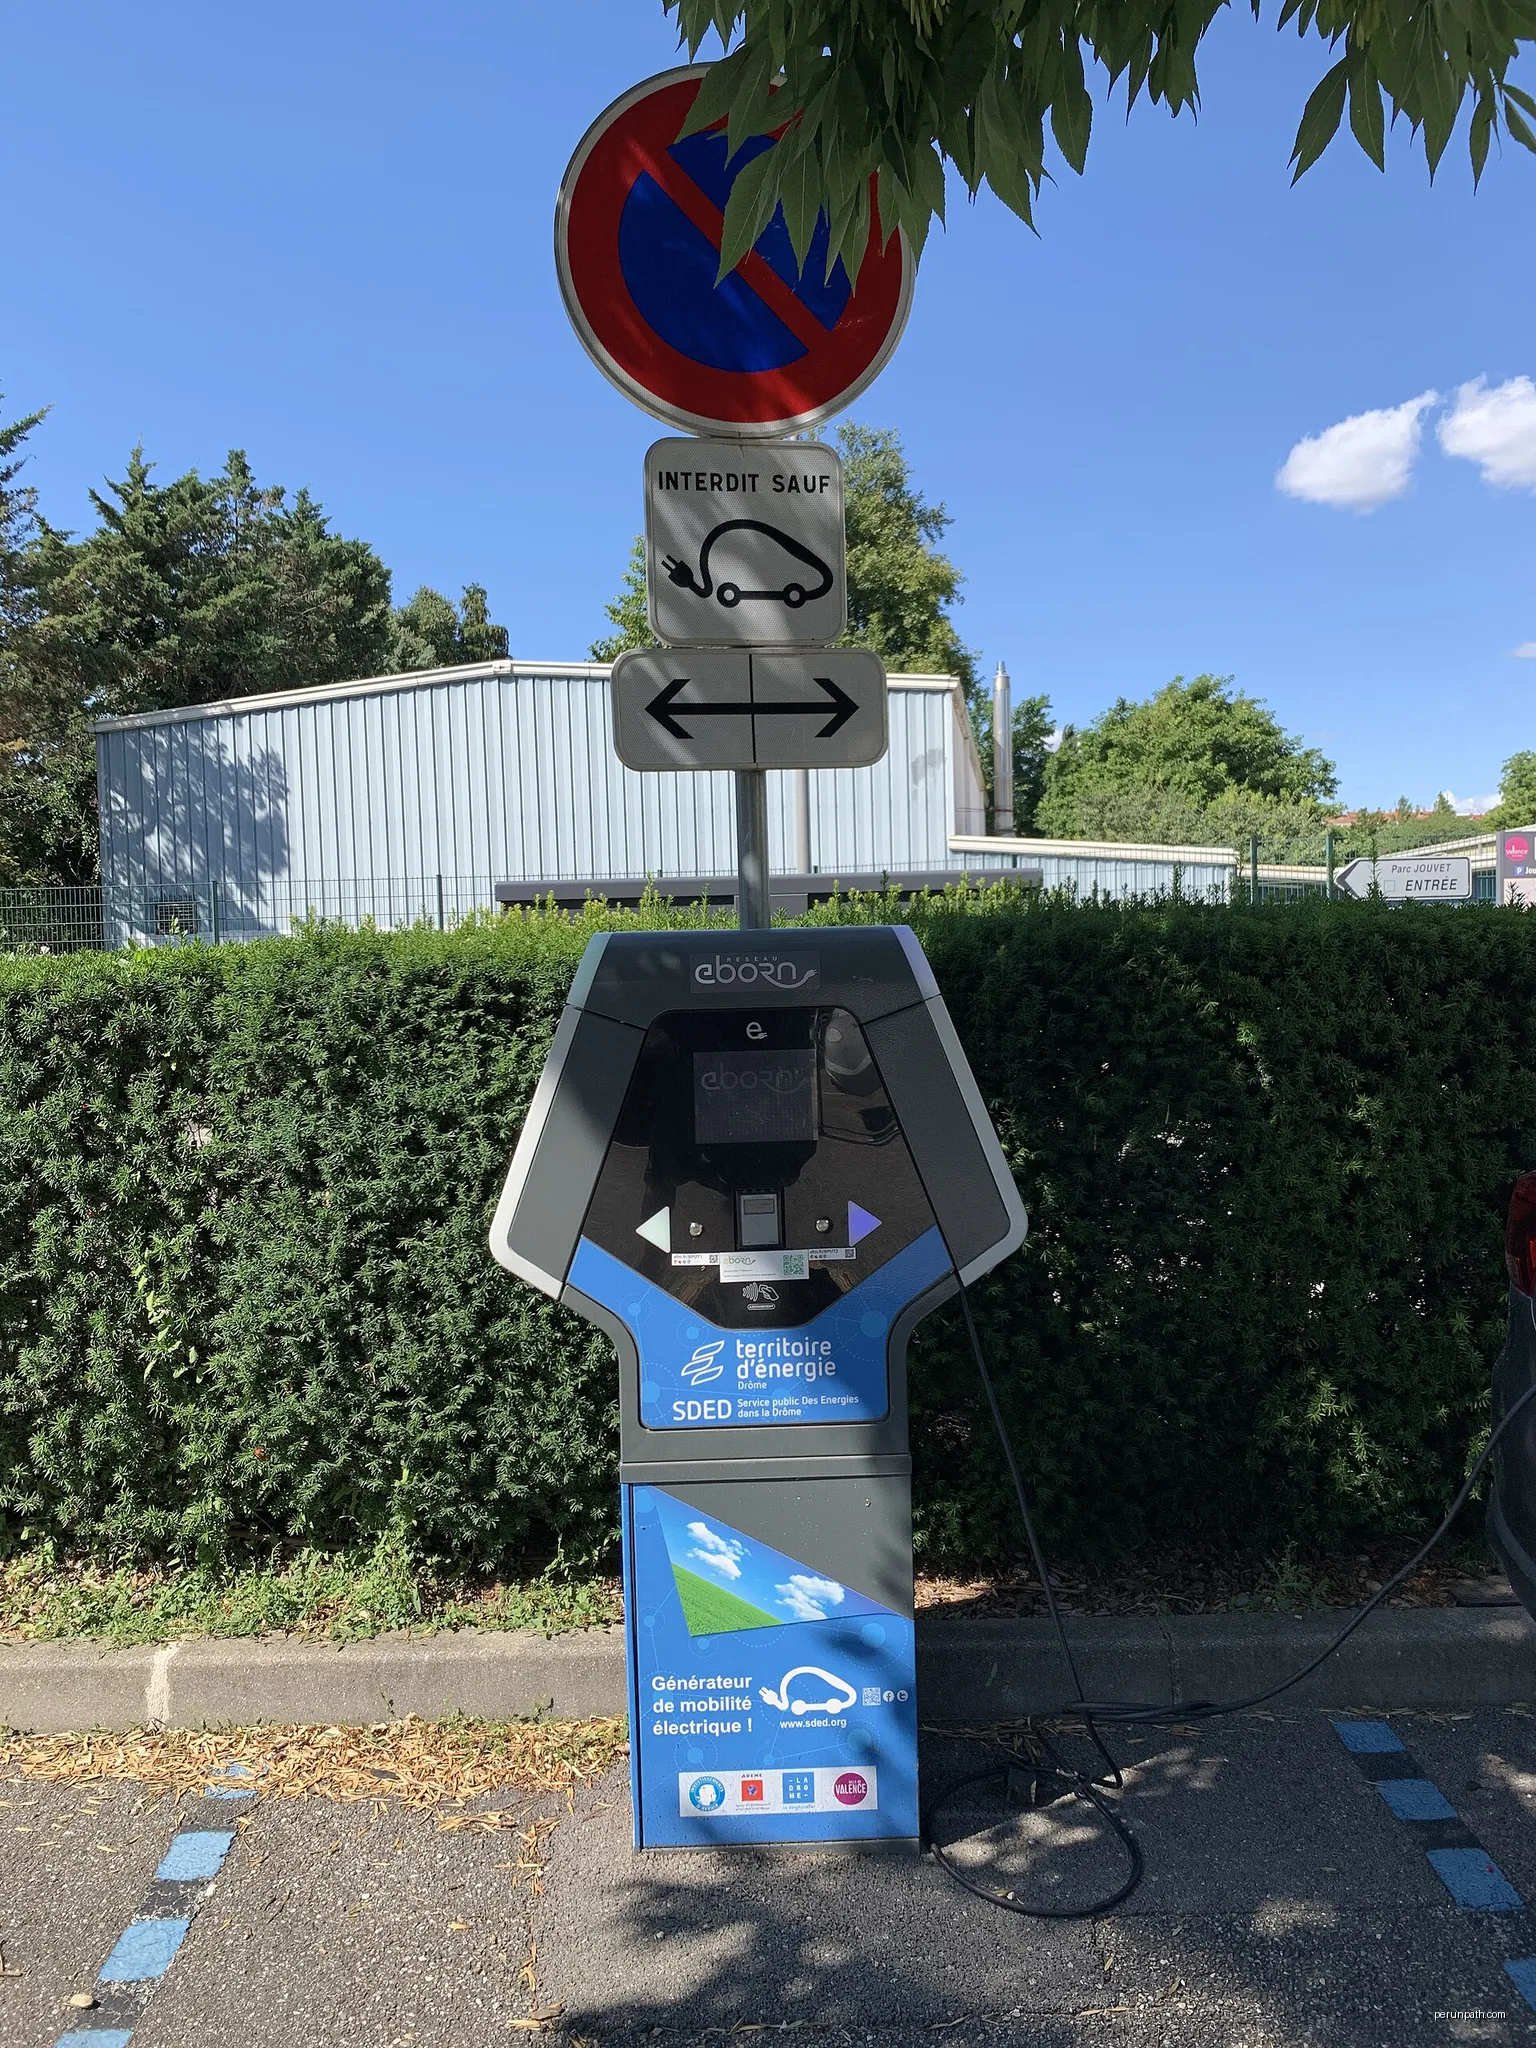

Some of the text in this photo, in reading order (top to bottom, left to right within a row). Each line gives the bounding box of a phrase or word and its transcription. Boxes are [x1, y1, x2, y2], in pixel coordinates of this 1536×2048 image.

[658, 471, 831, 494] INTERDIT SAUF
[1391, 863, 1452, 874] Parc JOUVET
[1405, 875, 1458, 892] ENTRÉE
[694, 955, 816, 989] eborn
[736, 1337, 832, 1359] territoire
[737, 1381, 767, 1390] Drôme
[737, 1395, 859, 1408] Service public Des Energies
[672, 1400, 732, 1421] SDED
[737, 1406, 802, 1418] dans la Drôme
[651, 1674, 753, 1692] Générateur
[652, 1695, 752, 1714] de mobilité
[652, 1719, 742, 1737] électrique
[780, 1717, 847, 1729] www.sded.org
[835, 1783, 866, 1795] VALENCE
